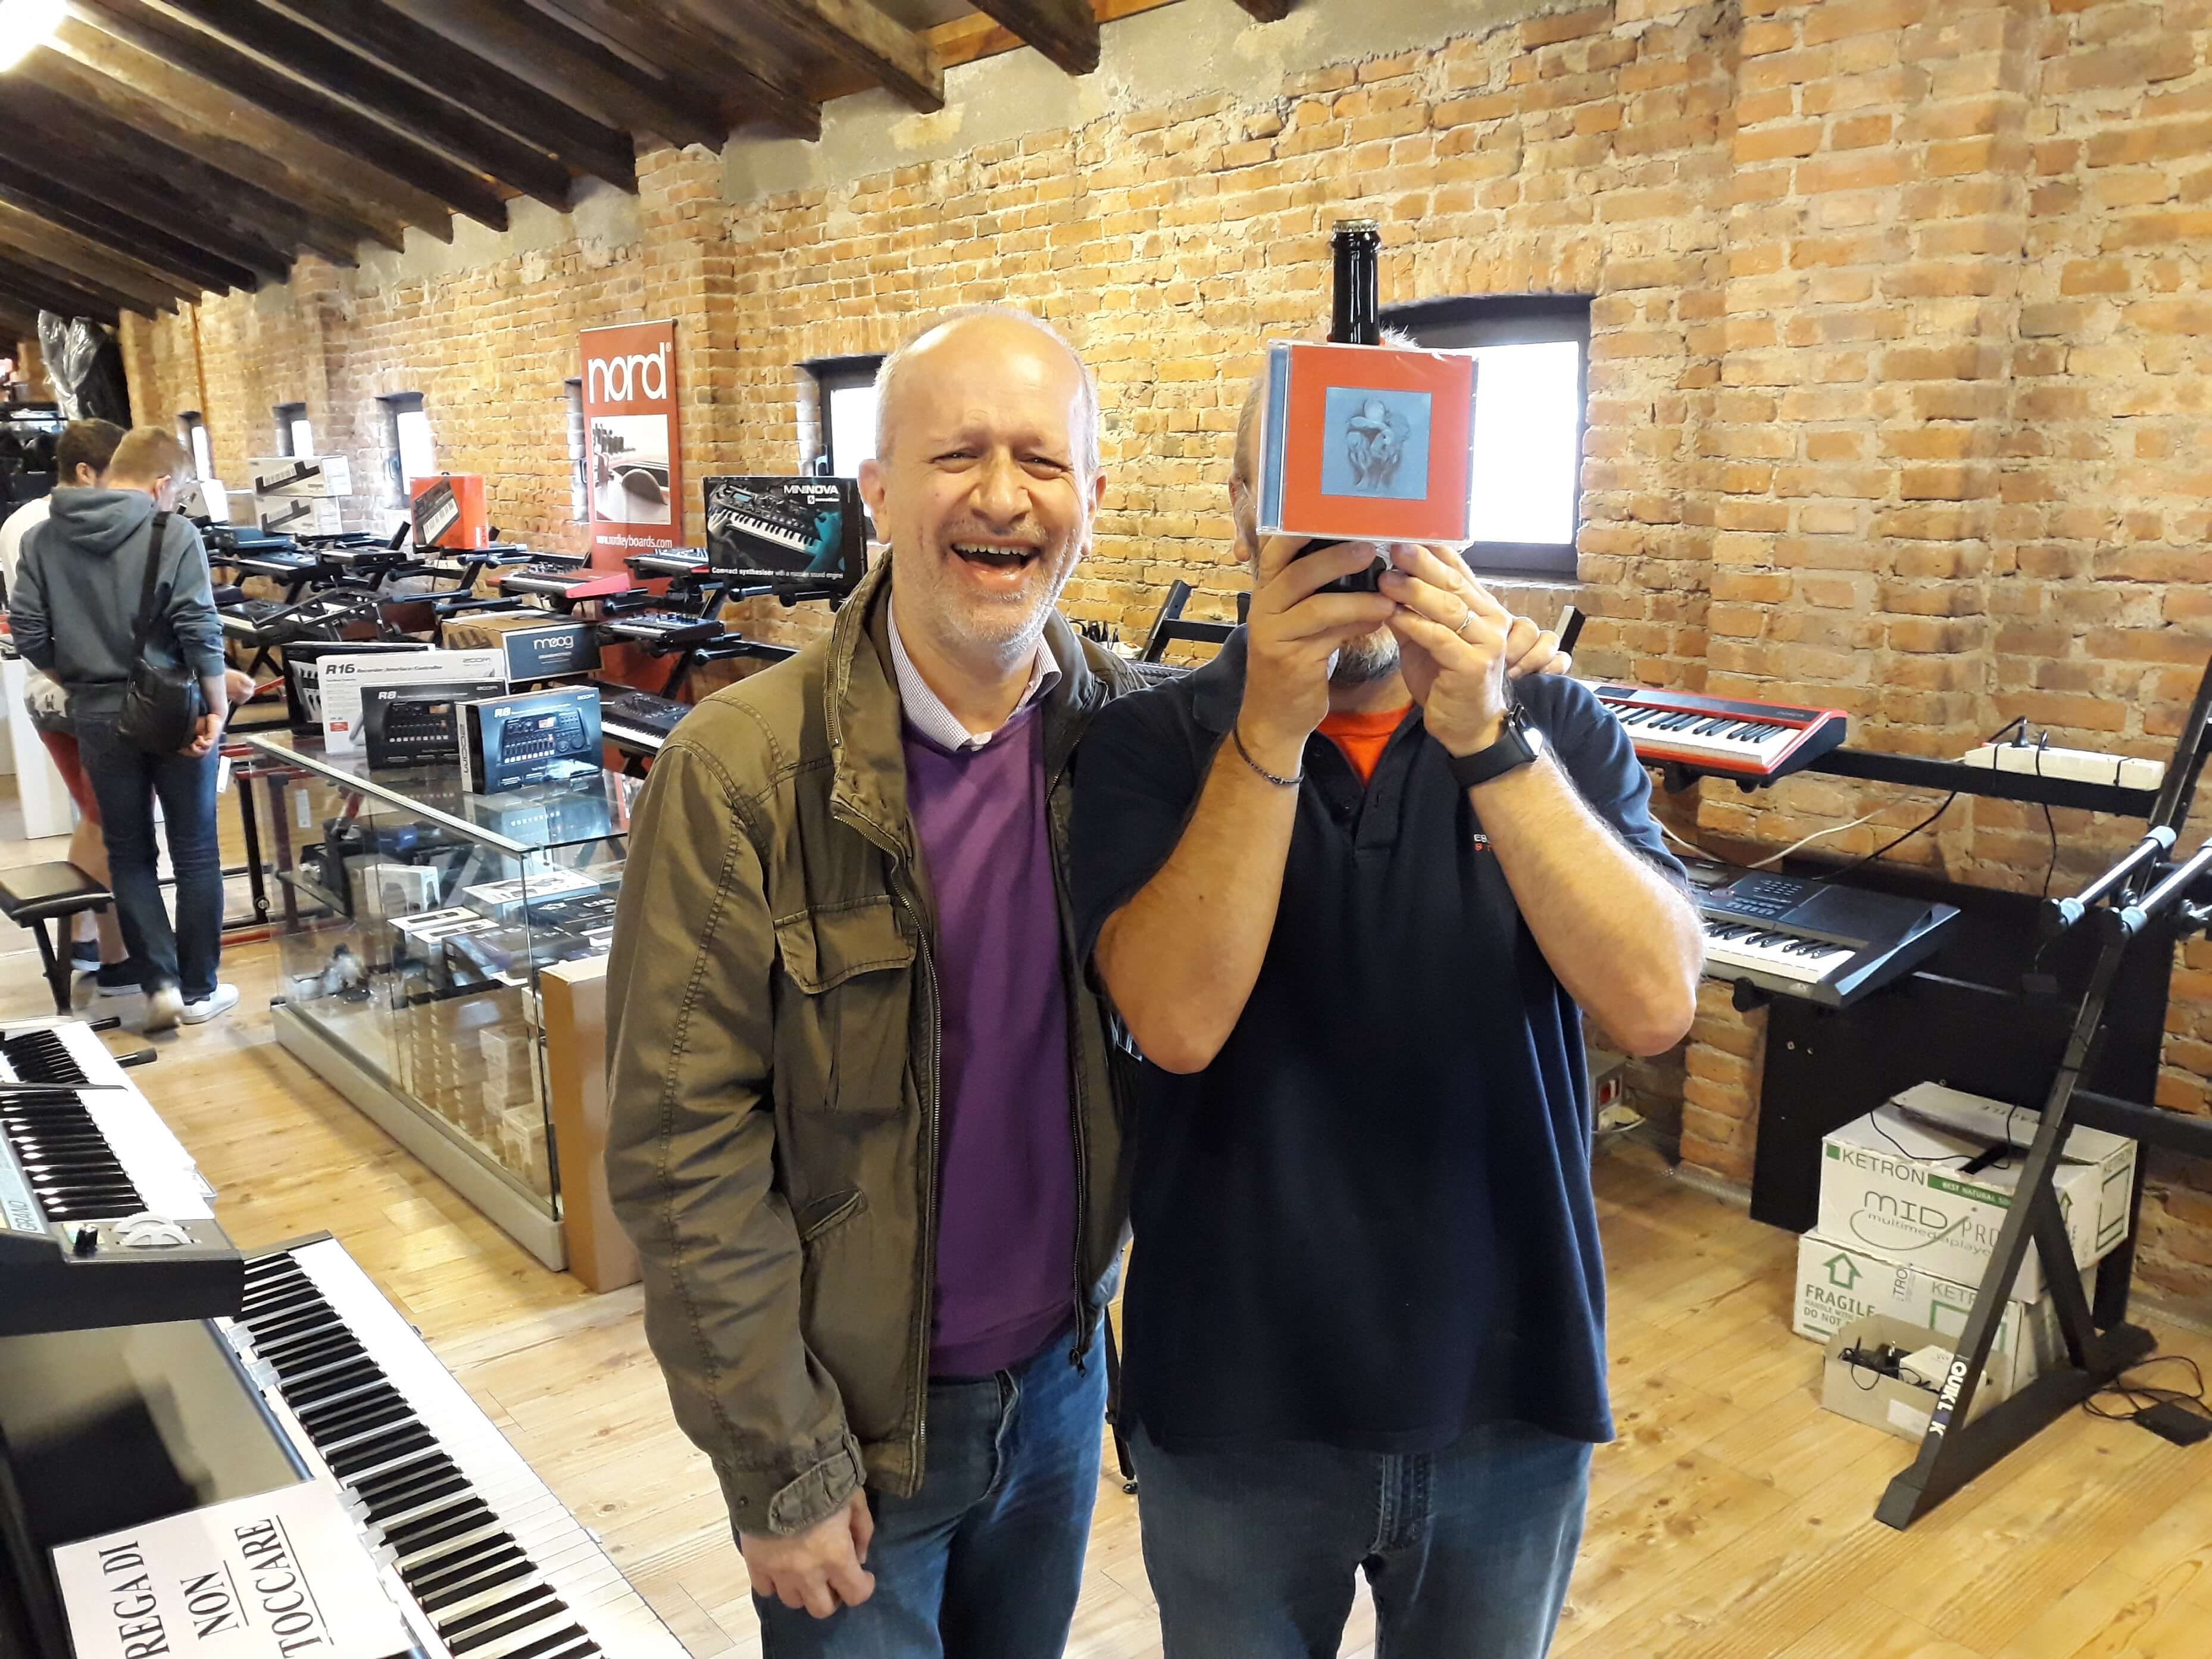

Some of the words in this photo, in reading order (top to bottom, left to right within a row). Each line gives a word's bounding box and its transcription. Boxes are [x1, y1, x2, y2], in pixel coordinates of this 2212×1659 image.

[587, 341, 667, 404] nord
[533, 635, 574, 650] moog
[326, 664, 356, 675] R16
[377, 691, 397, 700] R8
[1842, 1148, 1926, 1186] KETRON
[8, 1200, 38, 1232] GRAND
[1804, 1307, 1818, 1319] DO
[1822, 1313, 1842, 1326] NOT
[99, 1540, 146, 1576] DI
[233, 1518, 324, 1659] TOCCARE
[179, 1571, 240, 1641] NON
